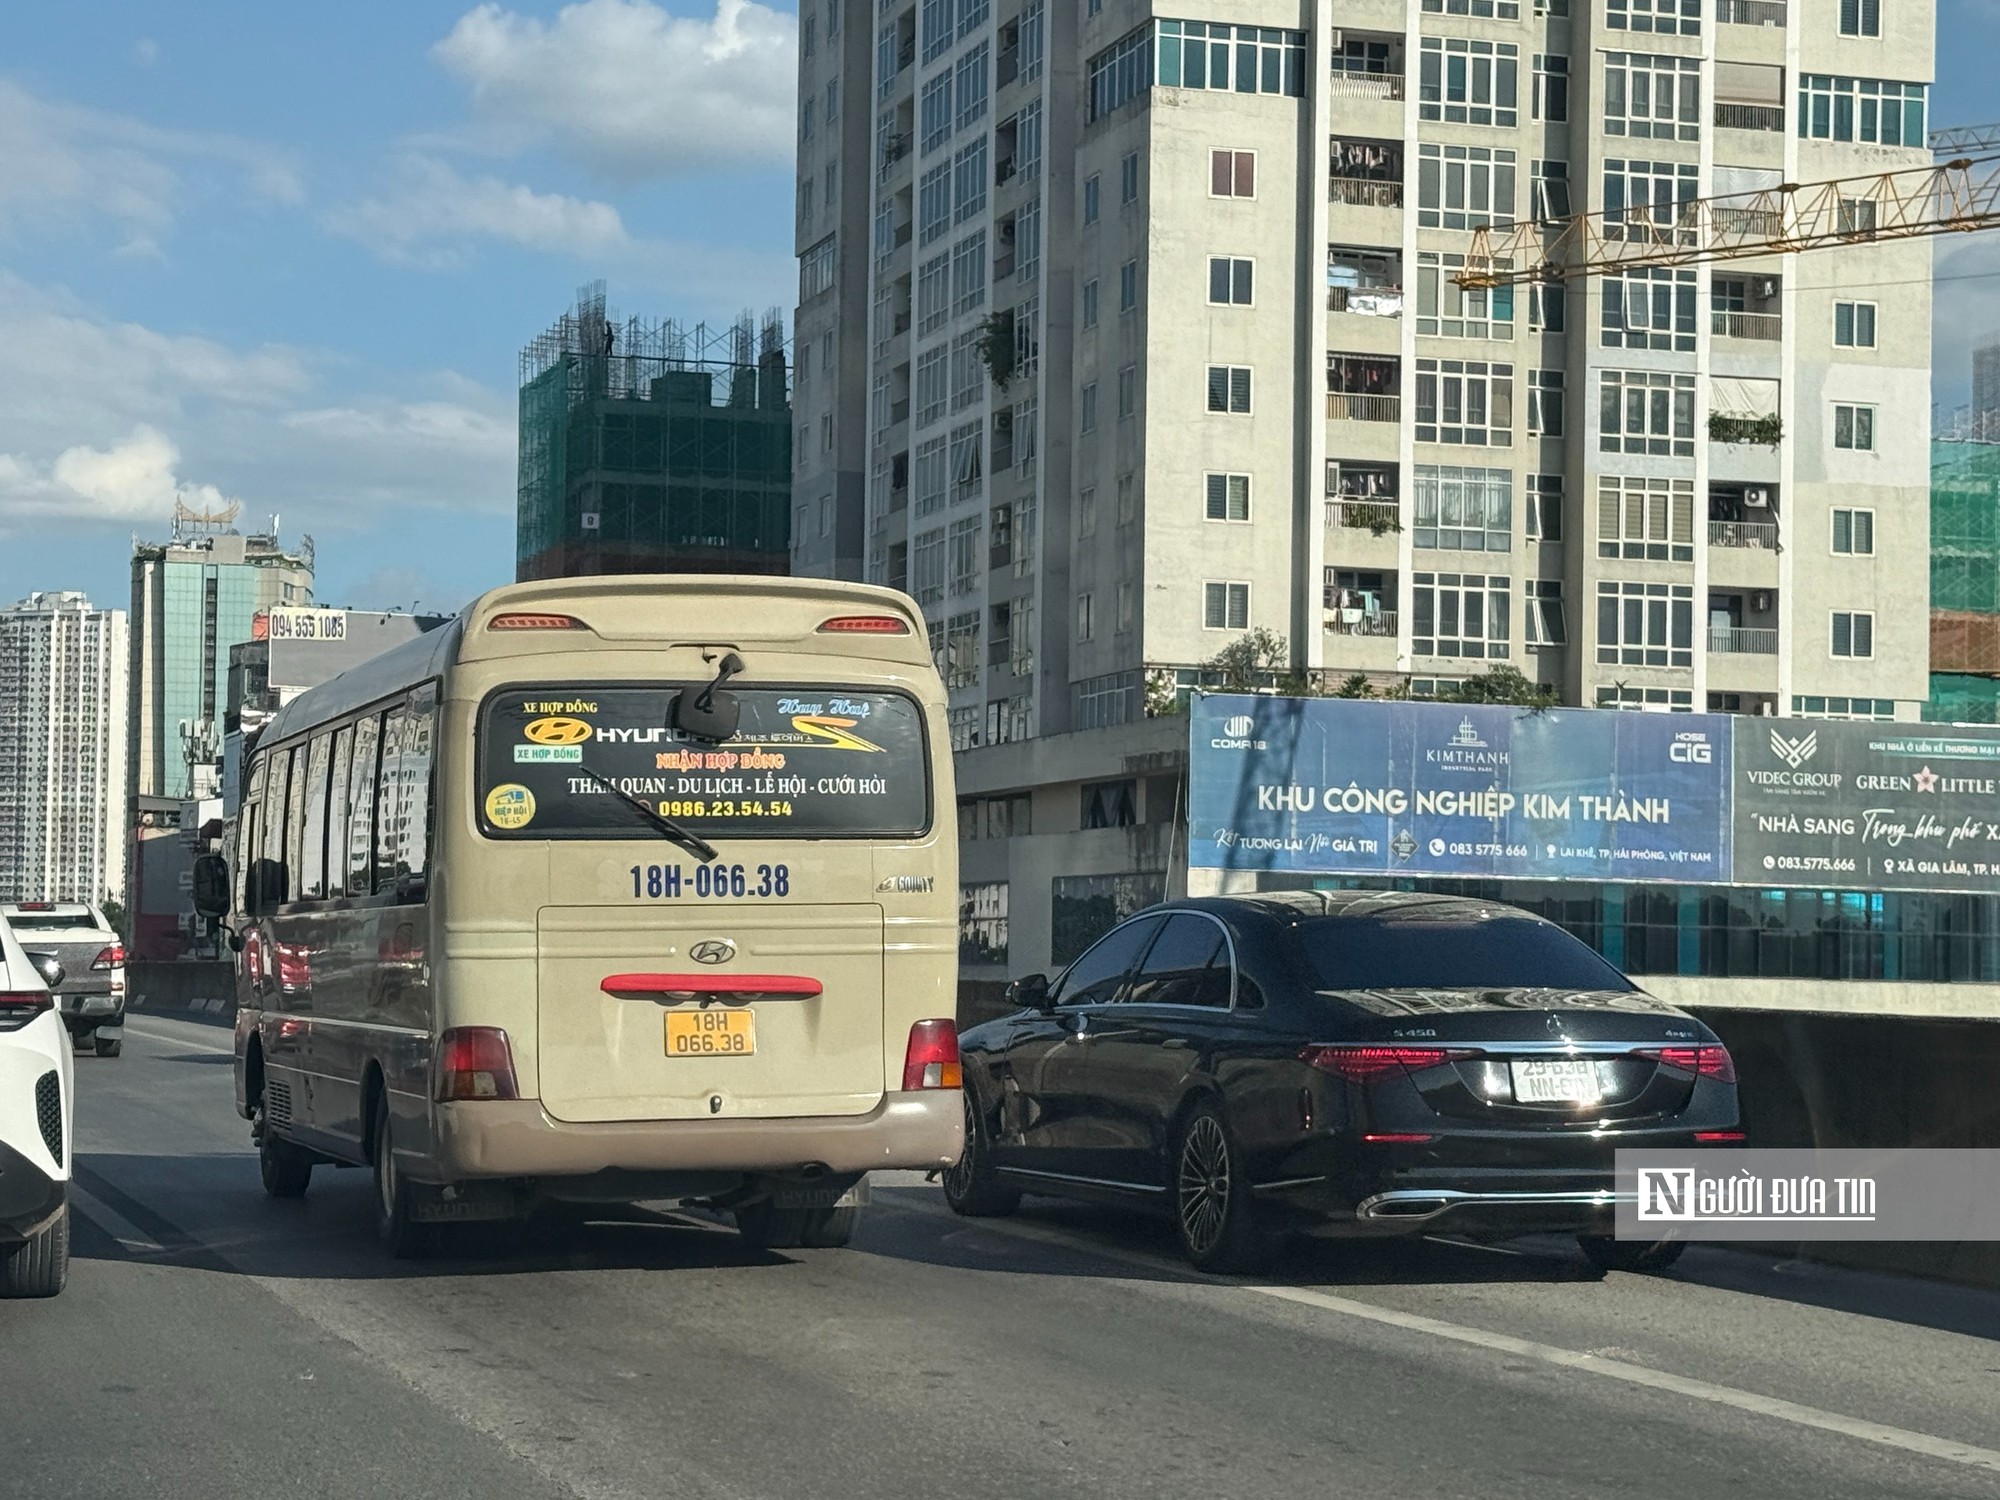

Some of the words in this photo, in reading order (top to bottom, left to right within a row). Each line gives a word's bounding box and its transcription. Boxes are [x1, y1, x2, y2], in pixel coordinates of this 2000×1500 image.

[272, 614, 292, 637] 094
[295, 614, 315, 638] 555
[318, 615, 344, 638] 1085
[523, 702, 537, 713] XE
[539, 701, 563, 716] HỢP
[1211, 738, 1252, 750] COMA
[1253, 740, 1267, 751] 18
[1869, 742, 1885, 750] KHU
[517, 749, 530, 759] XE
[532, 748, 551, 761] HỢP
[656, 749, 703, 772] NHẬN
[705, 751, 739, 772] HỢP
[1426, 748, 1508, 765] KIMTHANH
[620, 777, 667, 796] QUAN
[678, 777, 703, 794] DU
[705, 778, 743, 798] LỊCH
[778, 774, 807, 798] HỘI
[817, 774, 856, 795] CƯỚI
[1747, 771, 1791, 785] VIDEC
[1792, 773, 1842, 788] GROUP
[1856, 775, 1911, 792] GREEN
[1941, 778, 1996, 794] LITTLE
[659, 801, 793, 818] 0986.23.54.54
[1258, 785, 1315, 812] KHU
[1323, 780, 1408, 815] CÔNG
[1416, 785, 1515, 823] NGHIỆP
[1523, 793, 1571, 820] KIM
[1578, 789, 1670, 824] THÀNH
[1803, 818, 1855, 835] SANG
[1861, 809, 1914, 847] Trong
[1914, 815, 1946, 839] khu
[1986, 824, 2000, 840] X
[1284, 838, 1302, 850] LAI
[1331, 836, 1356, 853] GIÁ
[1358, 840, 1378, 855] TRỊ
[1449, 842, 1472, 856] 083
[1475, 844, 1502, 857] 5775
[1505, 844, 1528, 857] 666
[1560, 847, 1574, 857] LAI
[1669, 849, 1688, 863] VIỆT
[1690, 851, 1712, 863] NAM
[1777, 855, 1856, 871] 083.5775.666
[1897, 859, 1915, 873] XÃ
[1917, 861, 1941, 874] GIA
[1943, 859, 1971, 877] LÂM,
[1973, 864, 1989, 875] TP.
[630, 864, 789, 898] 18H-066.38
[692, 1013, 728, 1031] 18H
[676, 1034, 744, 1052] 066.38
